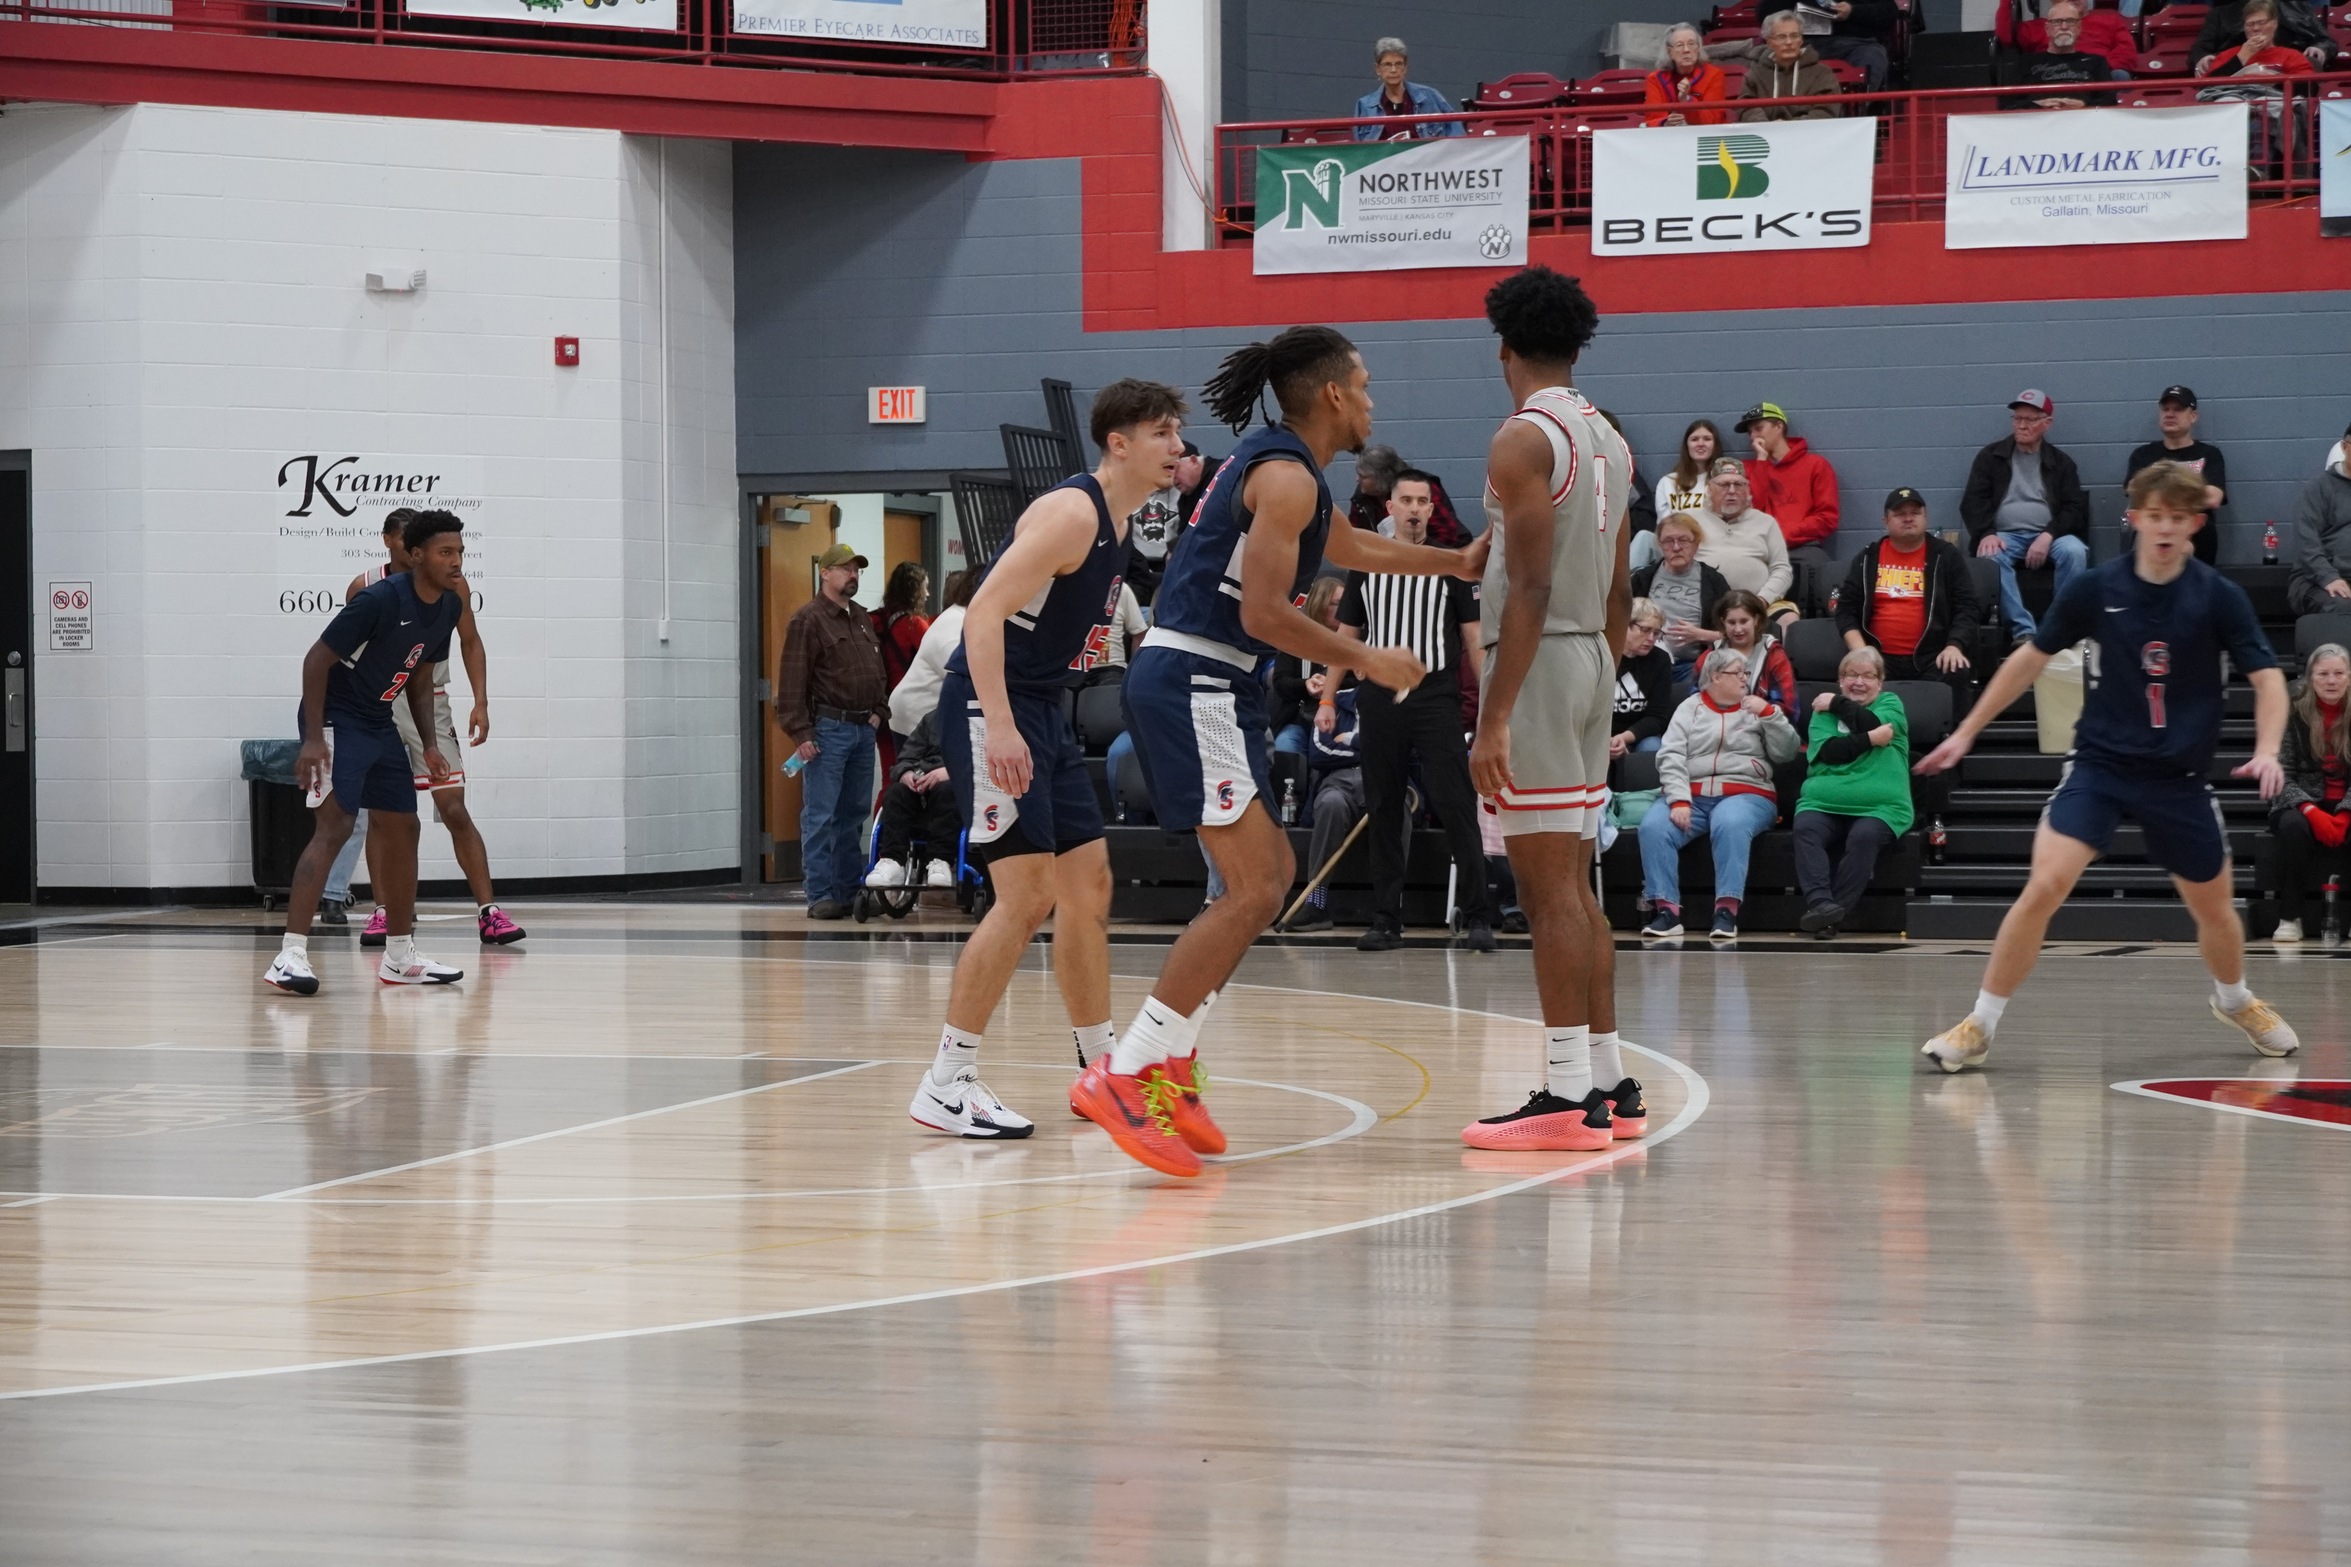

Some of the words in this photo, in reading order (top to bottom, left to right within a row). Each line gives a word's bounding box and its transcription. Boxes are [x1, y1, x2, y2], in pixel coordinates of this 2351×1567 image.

[738, 13, 807, 34] PREMIER
[814, 18, 885, 38] EYECARE
[889, 23, 980, 44] ASSOCIATES
[1976, 149, 2143, 178] LANDMARK
[2148, 145, 2222, 171] MFG.
[1359, 168, 1503, 194] NORTHWEST
[1359, 196, 1407, 207] MISSOURI
[1411, 194, 1440, 204] STATE
[1444, 191, 1503, 203] UNIVERSITY
[2010, 194, 2057, 206] CUSTOM
[2058, 192, 2095, 204] METAL
[2098, 190, 2173, 203] FABRICATION
[1359, 213, 1400, 222] MARYVILLE
[1404, 212, 1436, 221] KANSAS
[1437, 211, 1455, 219] CITY
[2096, 203, 2149, 216] Missouri
[1602, 209, 1862, 245] BECK'S
[1328, 228, 1452, 244] nwmissouri.edu
[879, 389, 915, 419] EXIT
[278, 455, 440, 517] Kramer
[355, 495, 423, 510] Contracting
[428, 496, 483, 511] Company
[279, 526, 355, 540] Design/Build
[341, 549, 360, 559] 303
[379, 671, 410, 701] 2
